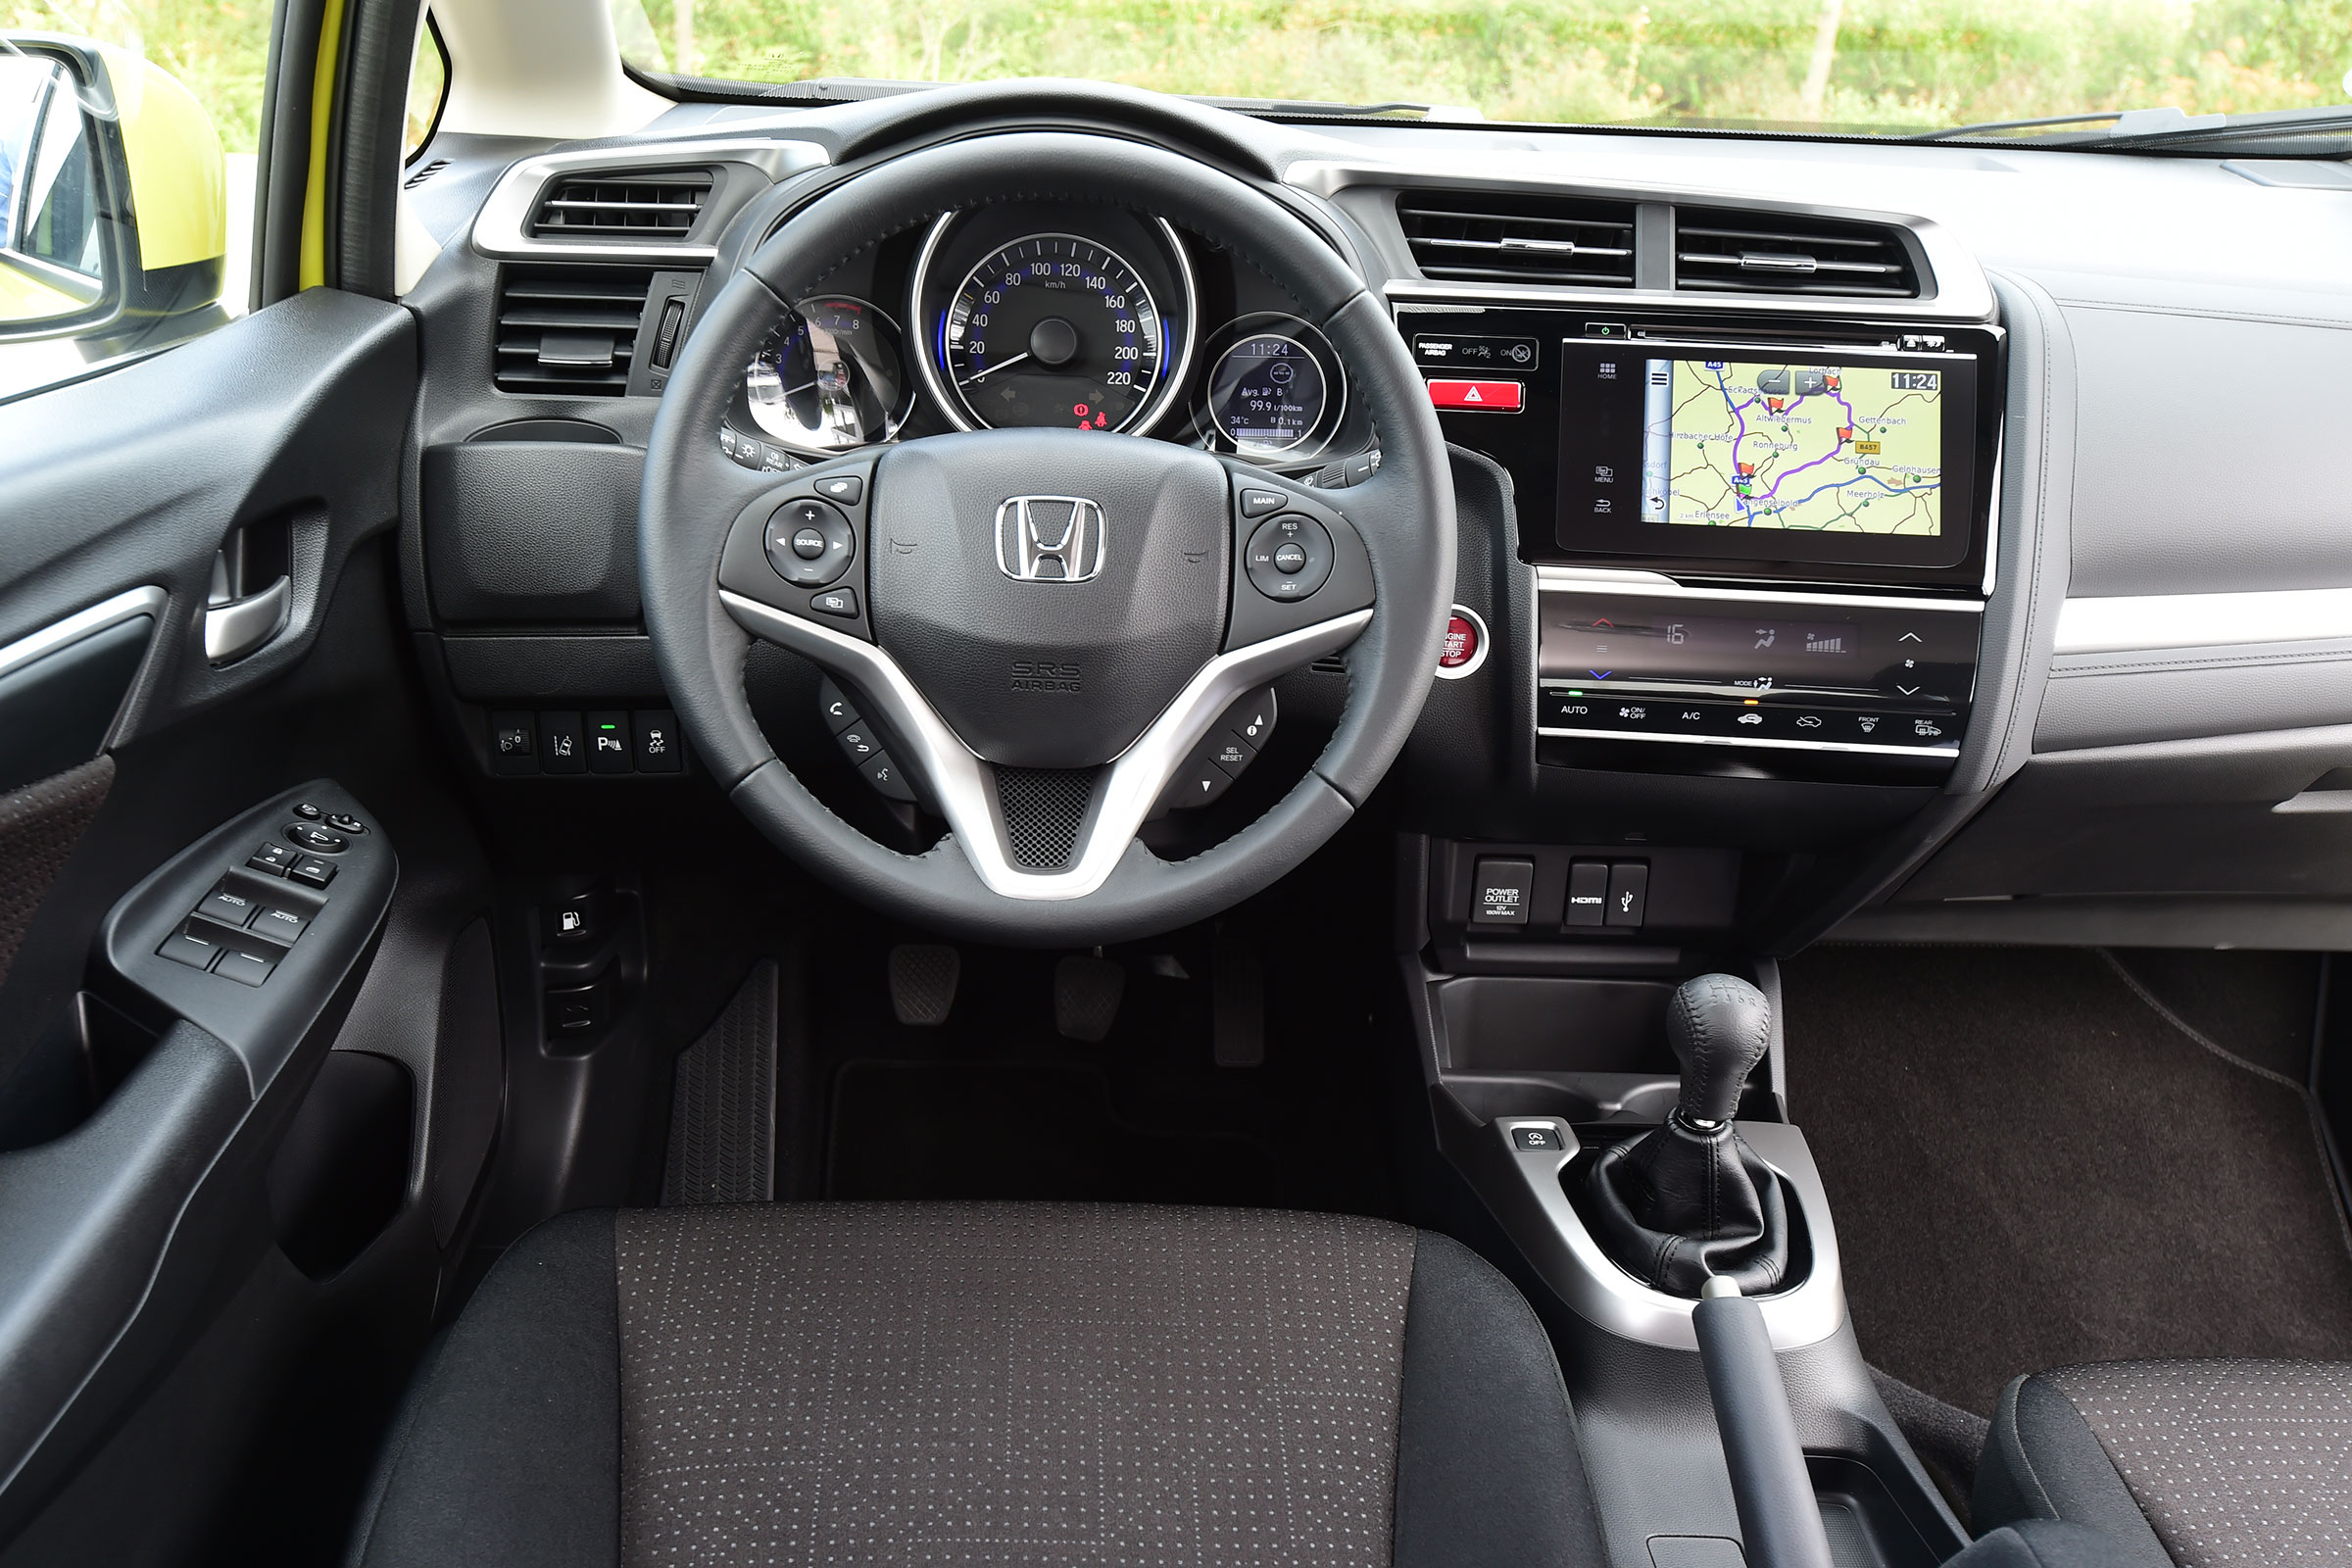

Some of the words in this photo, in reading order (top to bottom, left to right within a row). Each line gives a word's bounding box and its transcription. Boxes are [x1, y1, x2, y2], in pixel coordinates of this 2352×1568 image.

[1031, 262, 1052, 275] 100
[1060, 264, 1081, 277] 120
[1004, 272, 1021, 286] 80
[1045, 280, 1066, 289] km/h
[1085, 276, 1106, 290] 140
[984, 290, 1001, 304] 60
[1104, 295, 1125, 309] 160
[814, 317, 822, 327] 6
[834, 315, 841, 325] 7
[853, 318, 859, 330] 8
[972, 314, 989, 327] 40
[1115, 319, 1136, 333] 180
[797, 325, 805, 336] 5
[783, 336, 790, 346] 4
[969, 341, 985, 355] 20
[1114, 346, 1139, 360] 200
[1250, 343, 1289, 356] 11:24
[775, 353, 782, 364] 3
[1106, 371, 1131, 385] 220
[1892, 372, 1937, 390] 11:24
[1241, 387, 1259, 397] Avg.
[1250, 400, 1272, 411] 99.9
[1858, 416, 1906, 425] Gettenbach
[1753, 440, 1798, 451] Ronneburg
[1846, 489, 1885, 499] Meerholz
[1694, 510, 1731, 519] Erlensee
[795, 538, 823, 548] SOURCE
[1667, 623, 1685, 645] 16
[1011, 661, 1080, 678] SRS
[1011, 679, 1081, 693] AIRBAG
[1560, 706, 1589, 714] AUTO
[1682, 711, 1701, 720] A/C
[218, 894, 246, 906] AUTO
[270, 911, 298, 924] AUTO
